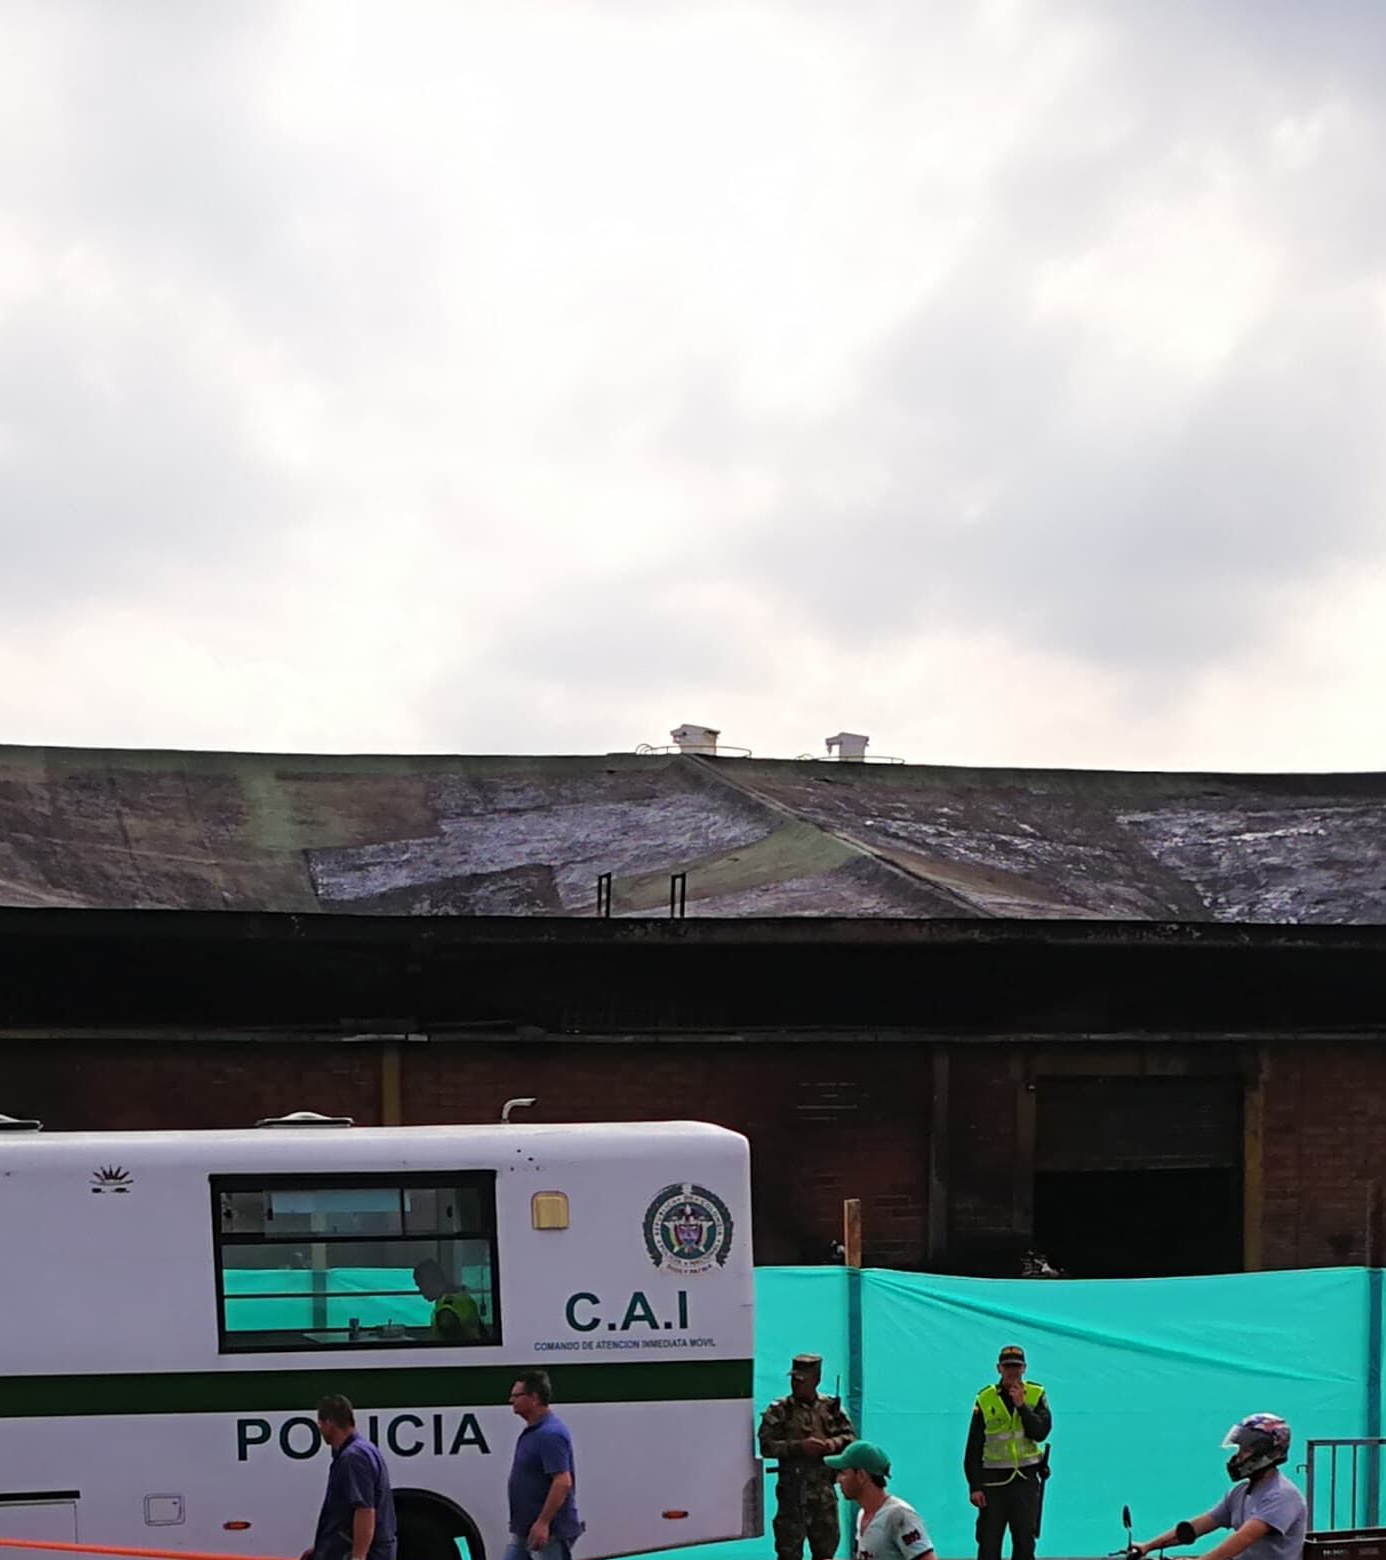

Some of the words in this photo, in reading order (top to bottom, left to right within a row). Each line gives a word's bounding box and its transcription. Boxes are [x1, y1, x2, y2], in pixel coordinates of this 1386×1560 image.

[565, 1290, 689, 1333] C.A.I
[534, 1341, 580, 1351] COMANDO
[582, 1341, 594, 1350] DE
[642, 1338, 687, 1349] INMEDIATA
[236, 1413, 491, 1461] POICIA
